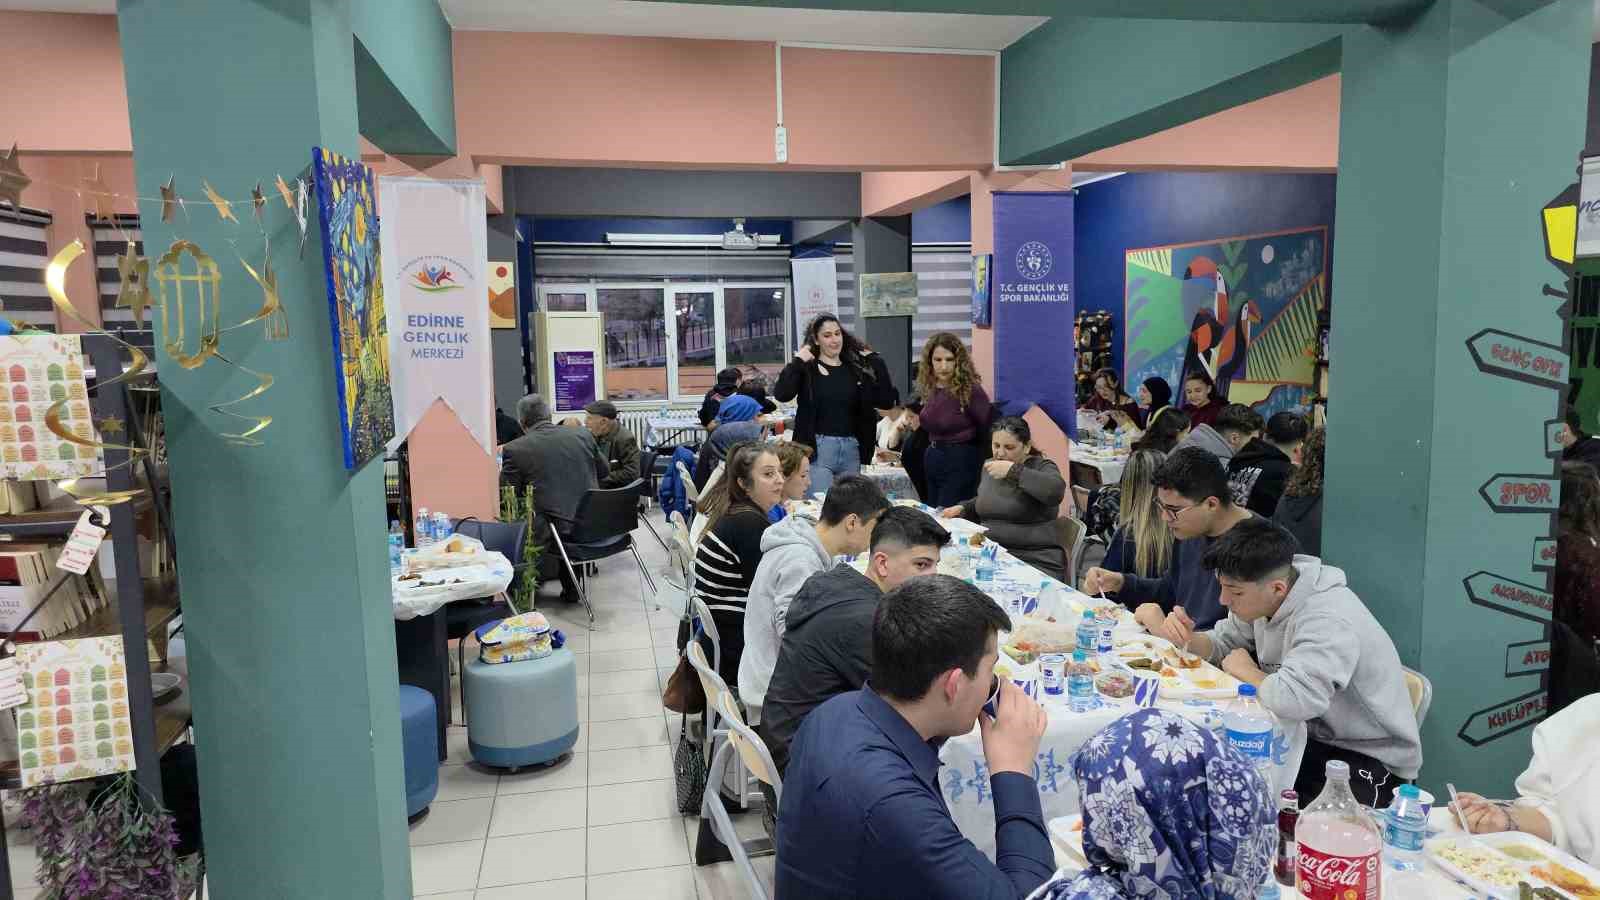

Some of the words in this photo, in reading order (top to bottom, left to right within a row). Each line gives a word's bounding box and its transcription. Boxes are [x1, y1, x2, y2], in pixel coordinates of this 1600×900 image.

[1000, 284, 1016, 292] T.C.
[1017, 282, 1055, 293] GENÇLİK
[1058, 283, 1069, 292] VE
[1000, 294, 1021, 302] SPOR
[1024, 292, 1069, 302] BAKANLIĞI
[408, 313, 464, 328] EDİRNE
[410, 346, 464, 359] MERKEZİ
[1500, 482, 1553, 504] SPOR
[1296, 843, 1365, 886] ca-Cola
